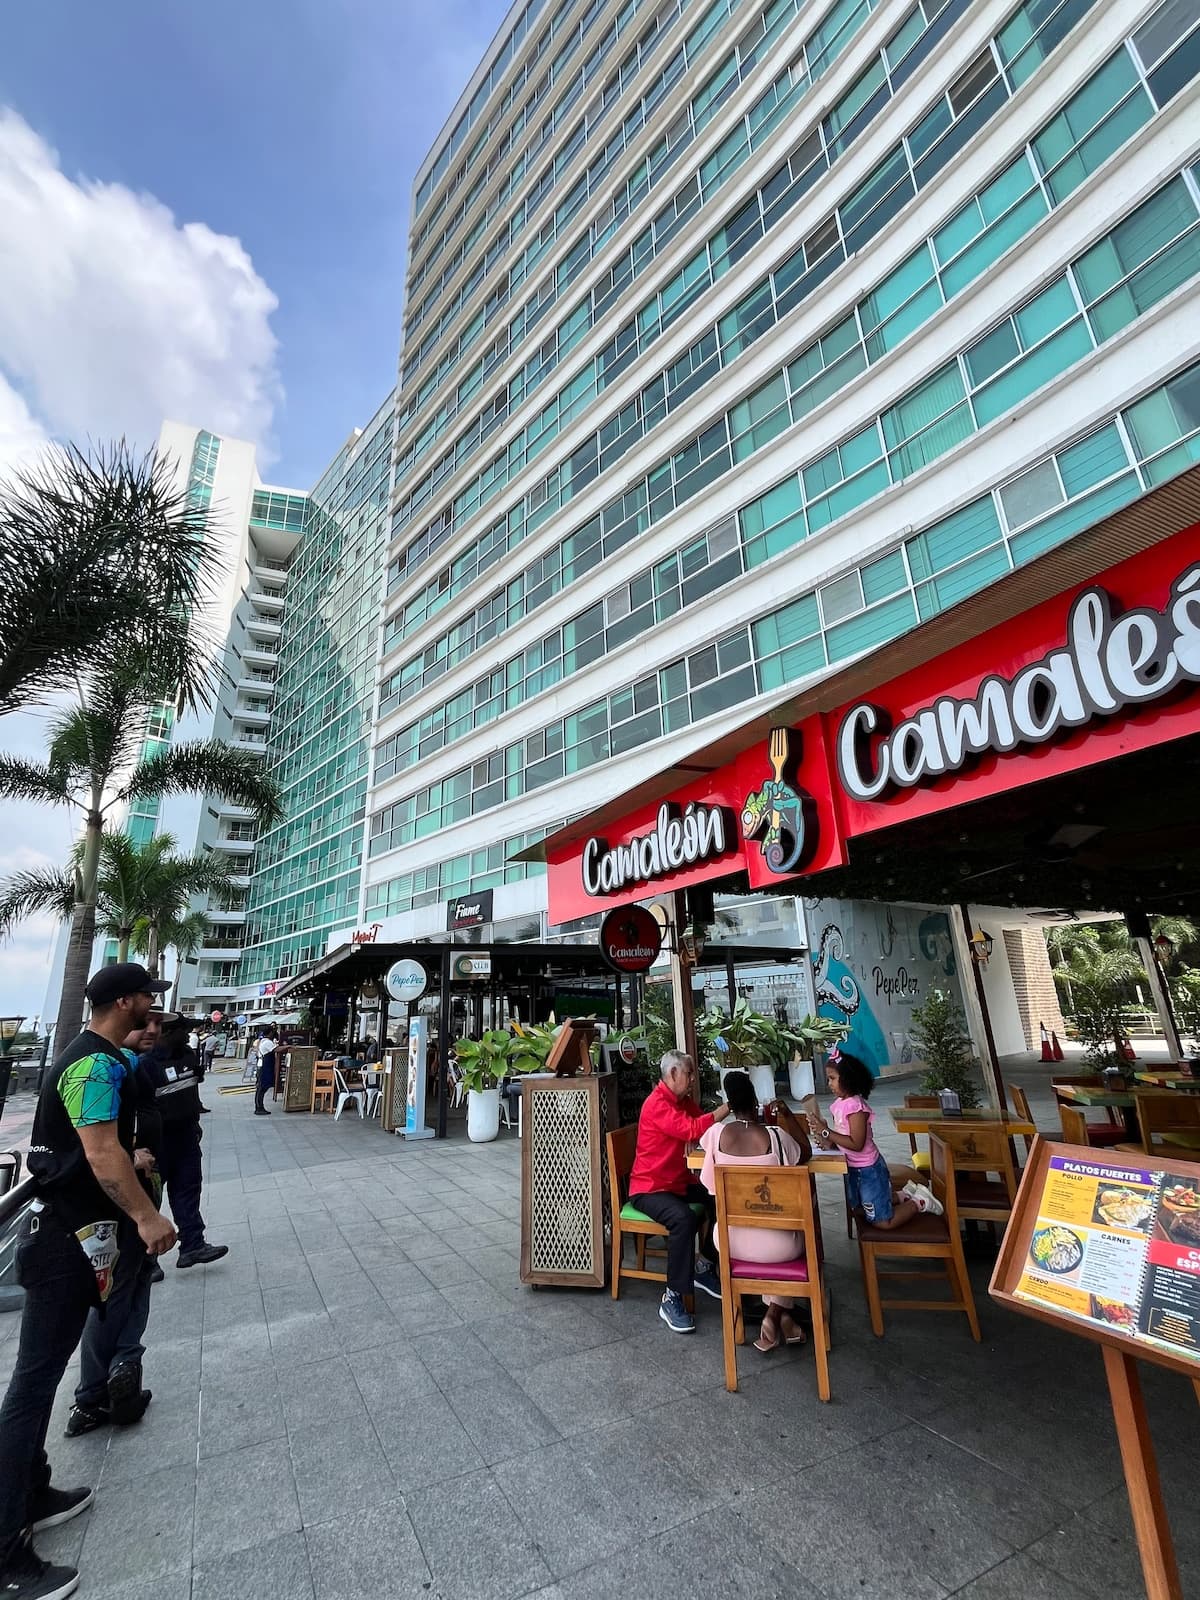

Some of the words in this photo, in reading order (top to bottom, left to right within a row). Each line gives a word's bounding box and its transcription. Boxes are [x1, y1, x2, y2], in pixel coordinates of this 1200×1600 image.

[583, 802, 724, 896] Camaleón
[1062, 1173, 1083, 1181] POLLO
[1063, 1162, 1100, 1177] PLATOS
[1100, 1168, 1142, 1182] FUERTES
[1101, 1233, 1131, 1245] CARNES
